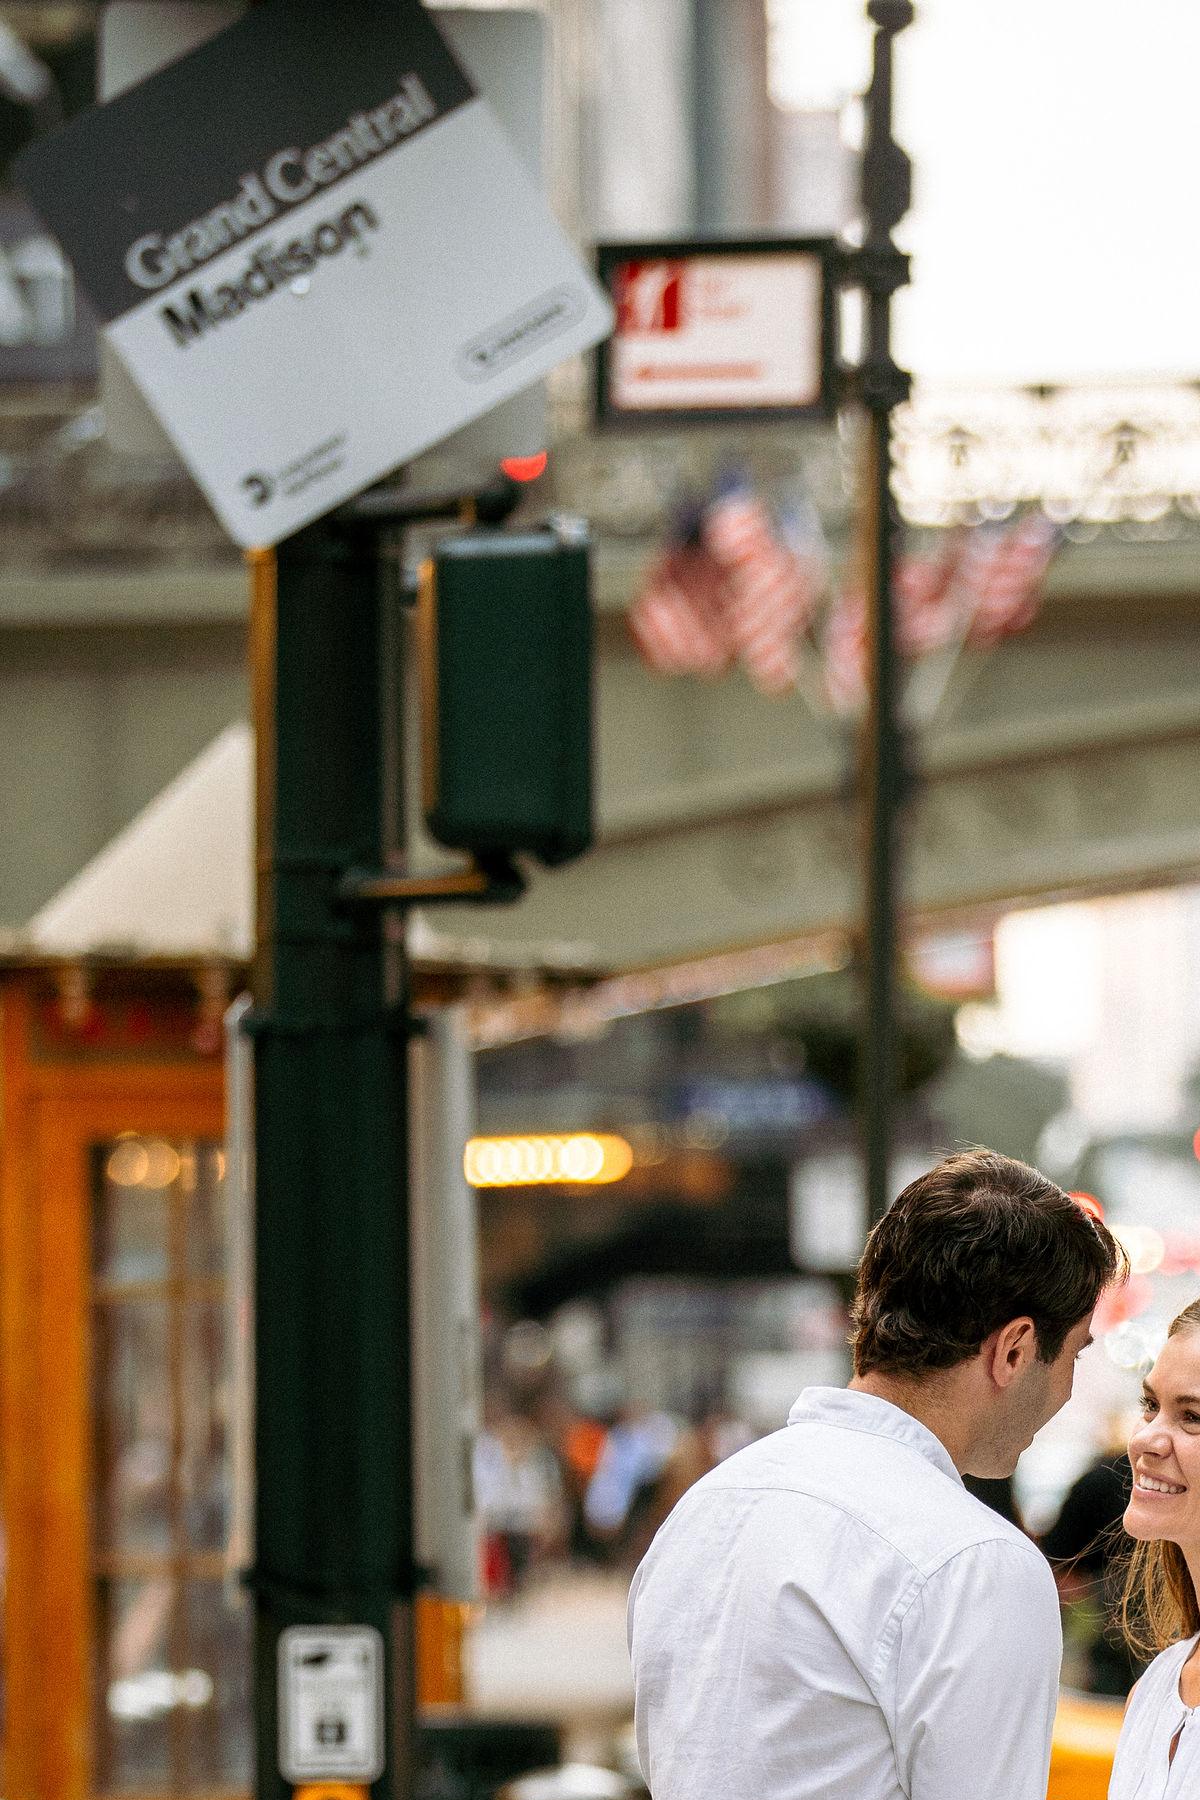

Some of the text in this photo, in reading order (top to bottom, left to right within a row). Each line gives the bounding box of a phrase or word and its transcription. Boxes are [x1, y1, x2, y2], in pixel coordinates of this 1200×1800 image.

[125, 70, 438, 290] Grand Central
[159, 202, 381, 348] Madison
